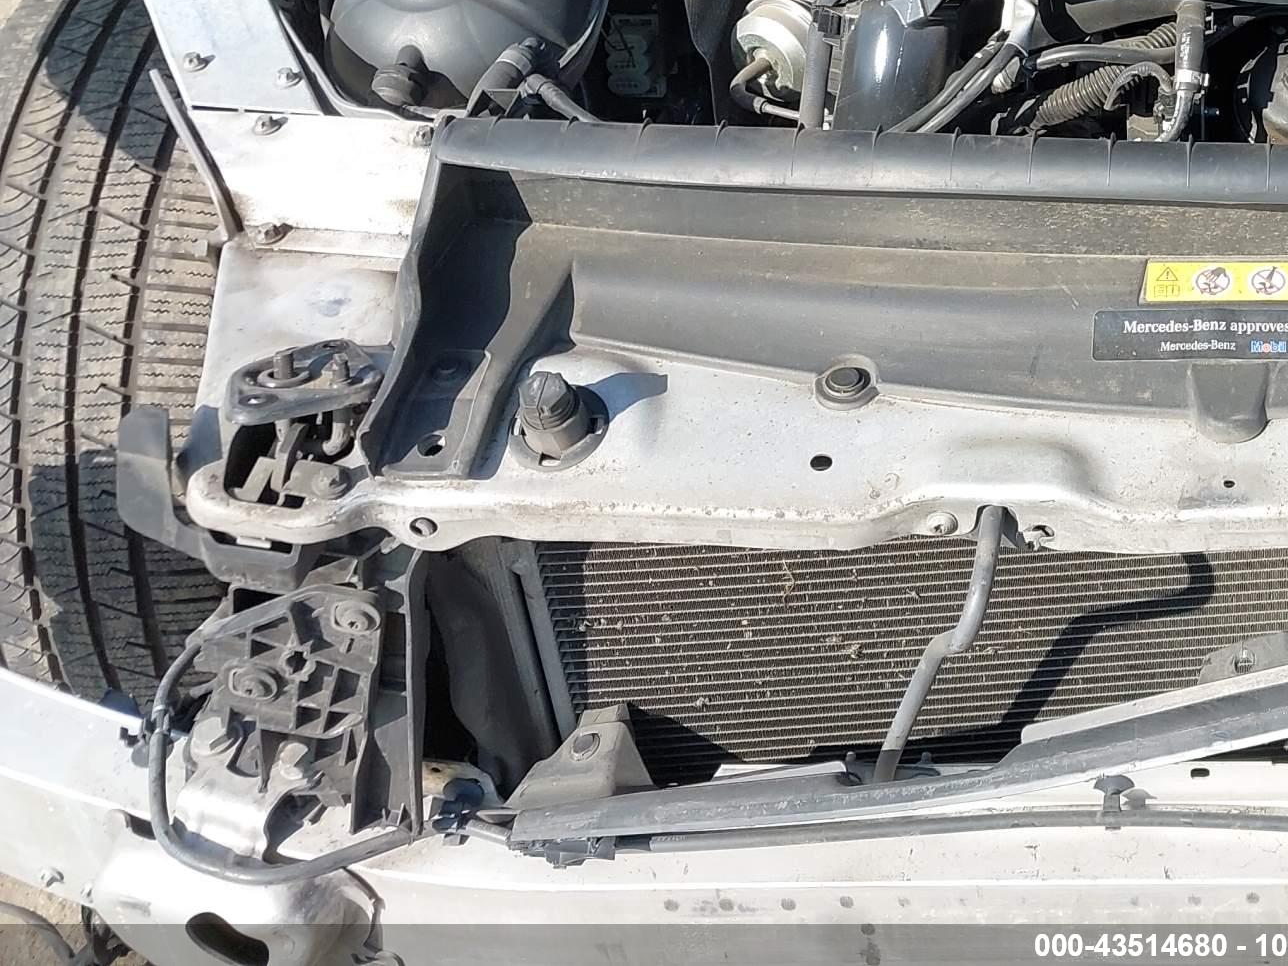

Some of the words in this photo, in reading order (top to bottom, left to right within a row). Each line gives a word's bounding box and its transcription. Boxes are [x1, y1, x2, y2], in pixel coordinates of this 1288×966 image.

[1123, 319, 1227, 334] Mercedes-Benz
[1160, 339, 1236, 352] Mercedes-Benz
[1250, 340, 1287, 353] Mobil
